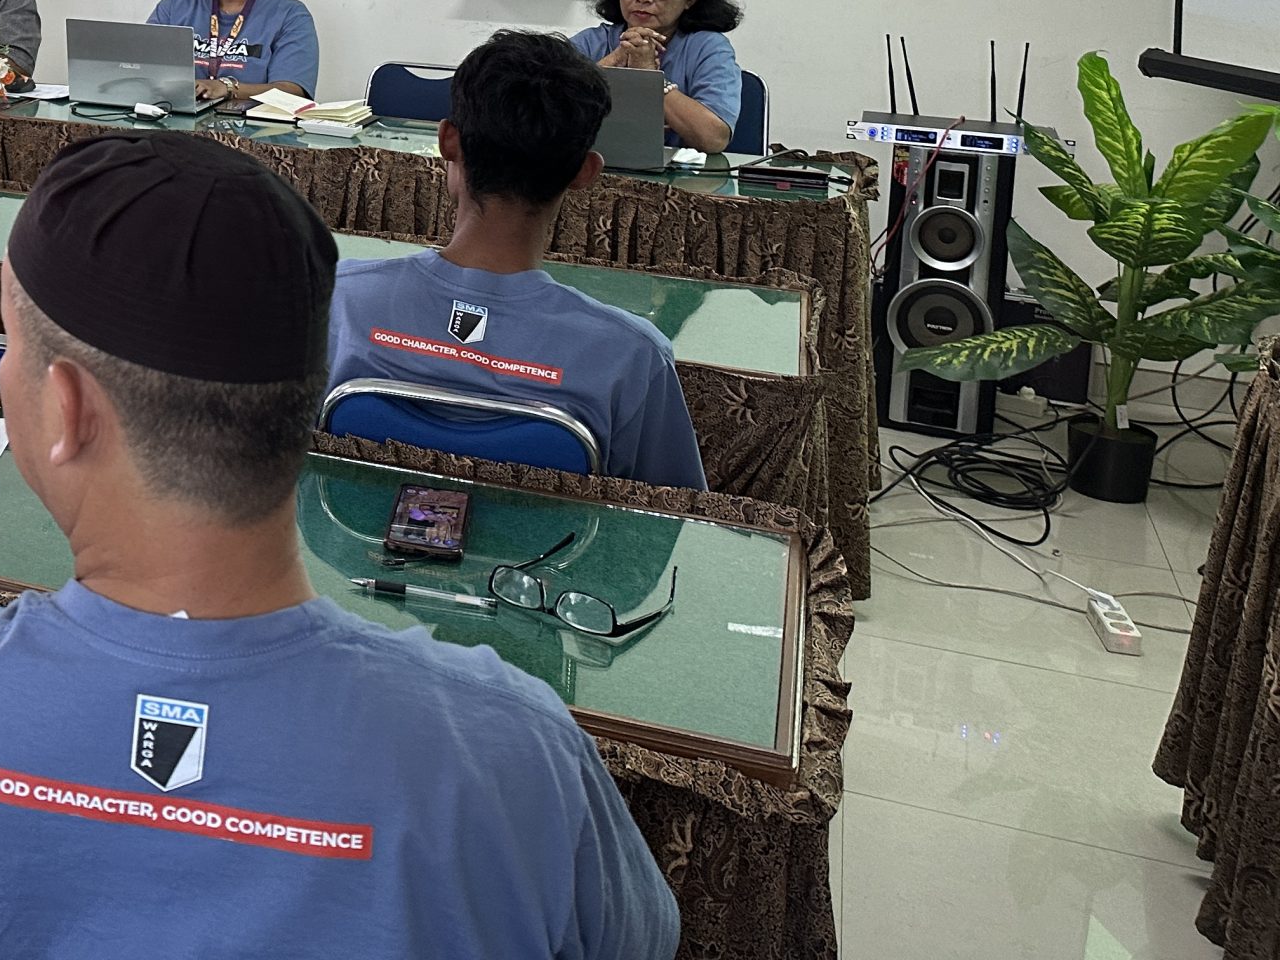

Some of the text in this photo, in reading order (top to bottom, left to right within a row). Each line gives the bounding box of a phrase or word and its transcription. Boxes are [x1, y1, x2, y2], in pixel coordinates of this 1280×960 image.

[453, 311, 464, 333] WARGA
[456, 302, 485, 314] SMA
[374, 332, 558, 380] GOOD CHARACTER, GOOD COMPETENCE
[143, 701, 202, 723] SMA
[140, 721, 159, 768] WARGA
[33, 785, 159, 821] CHARACTER,
[161, 805, 222, 829] GOOD
[224, 816, 363, 850] COMPETENCE
